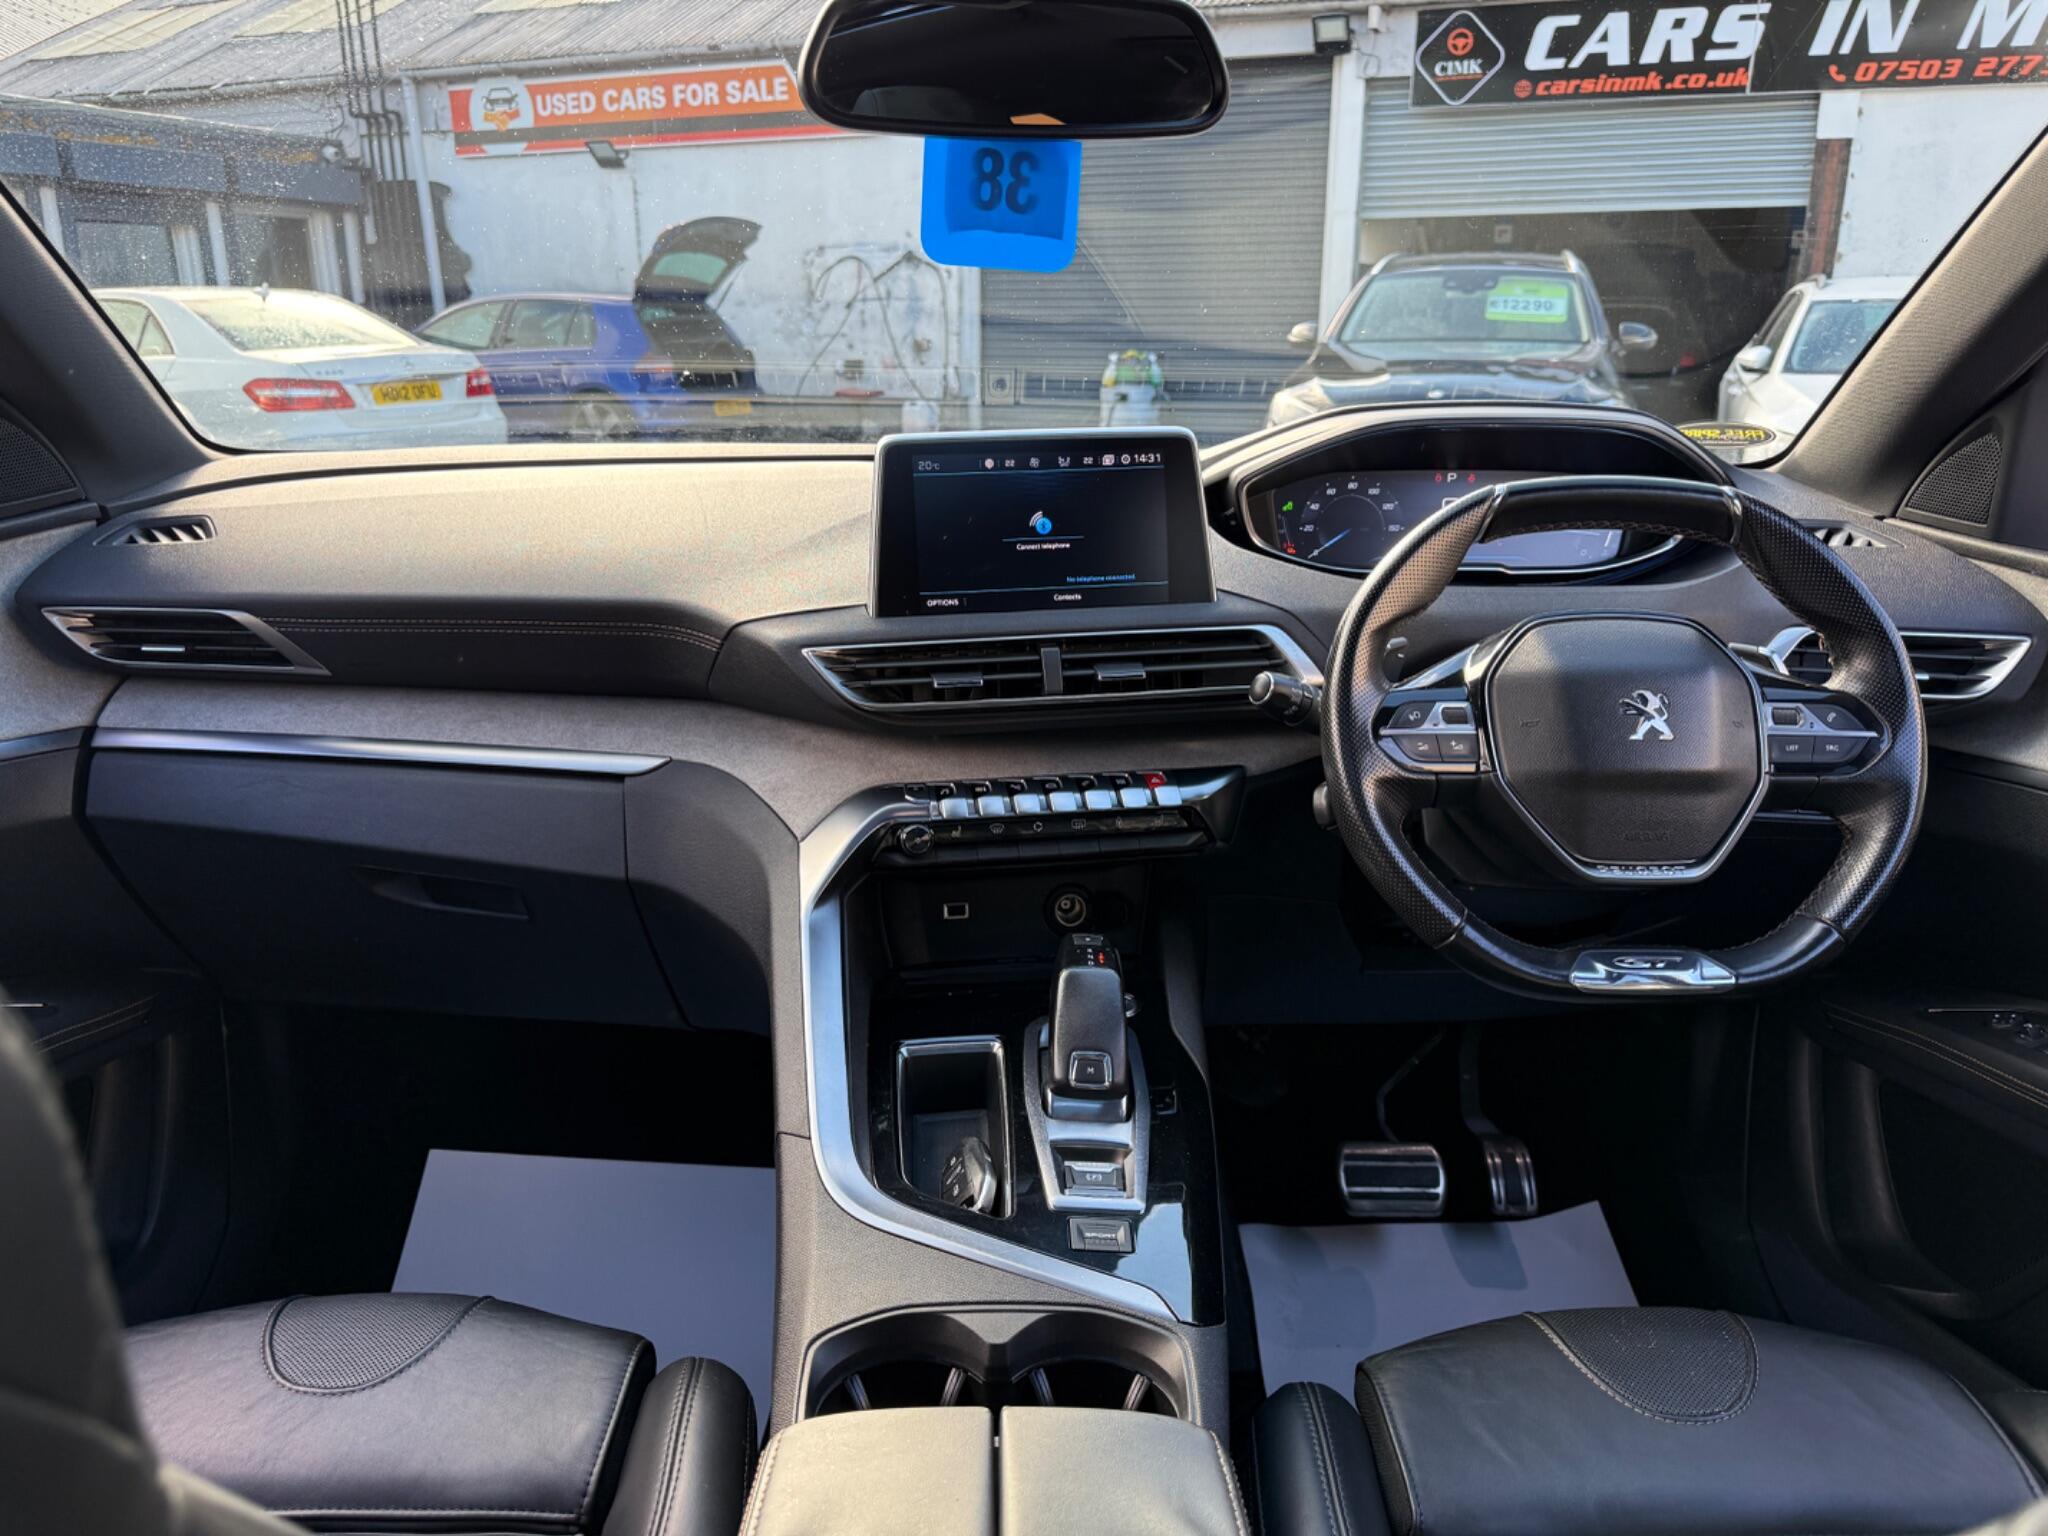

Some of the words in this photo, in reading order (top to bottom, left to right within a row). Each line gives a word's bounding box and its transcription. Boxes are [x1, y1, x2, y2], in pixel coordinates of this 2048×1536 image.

[1523, 1, 1773, 72] CARS
[1807, 0, 1918, 57] IN
[1955, 0, 2048, 51] M
[1433, 58, 1484, 77] CIMK
[1854, 58, 1964, 83] 07503
[1535, 67, 1750, 97] carsinmk.co.uk
[535, 91, 597, 117] USED
[602, 86, 667, 112] CARS
[671, 82, 721, 107] FOR
[725, 76, 789, 103] SALE
[1133, 453, 1161, 463] 14:31
[1447, 472, 1457, 483] P
[926, 598, 960, 607] OPTIONS
